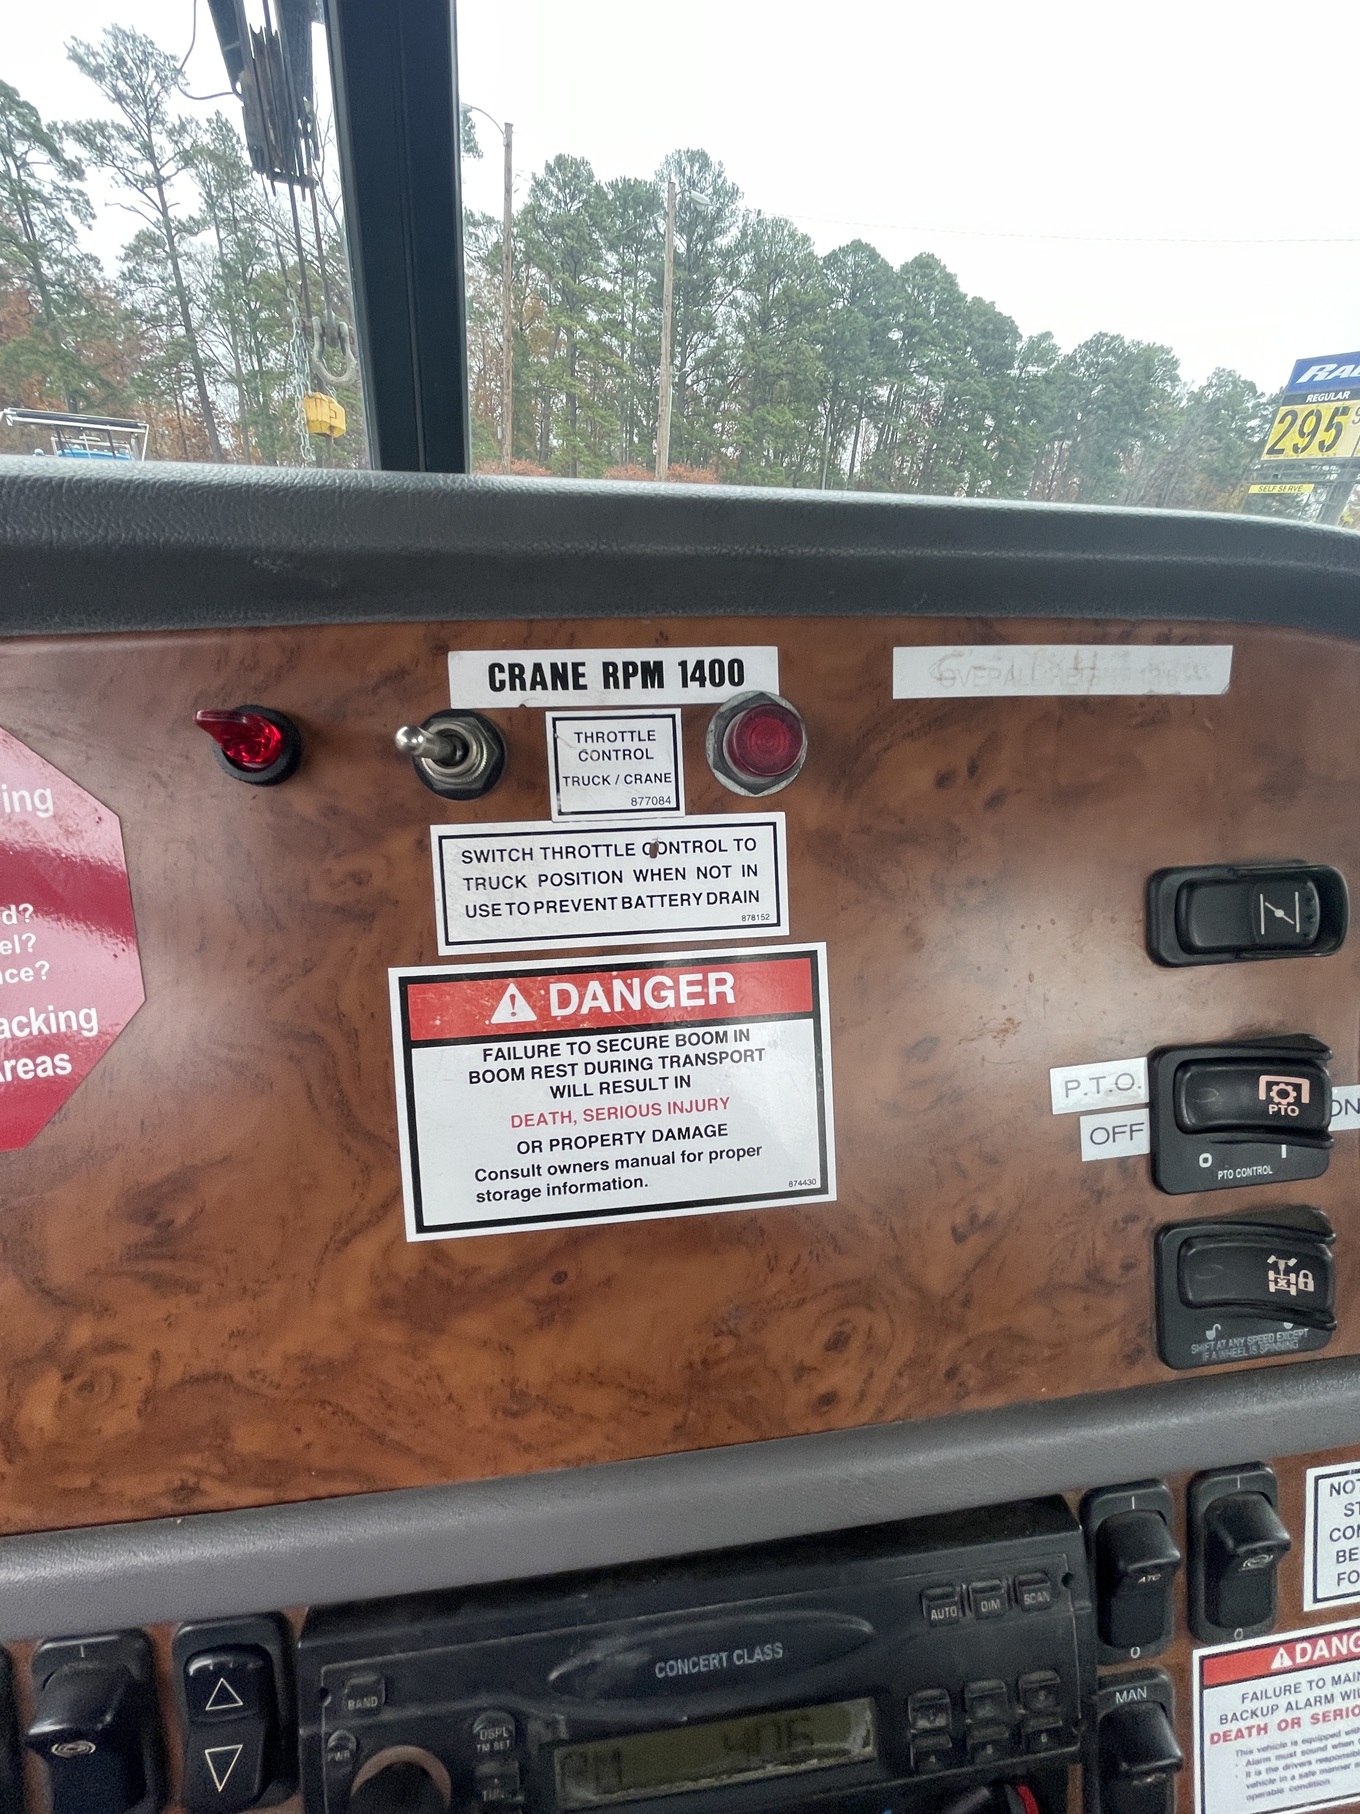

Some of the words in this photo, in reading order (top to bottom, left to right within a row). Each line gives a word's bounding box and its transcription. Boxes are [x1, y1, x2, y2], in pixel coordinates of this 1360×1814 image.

[1306, 390, 1351, 403] REGULAR
[1266, 405, 1351, 456] 295
[1258, 485, 1277, 493] SELF
[1278, 484, 1303, 493] SERVE
[488, 661, 588, 693] CRANE
[602, 659, 665, 690] RPM
[677, 657, 745, 688] 1400
[574, 730, 657, 744] THROTTLE
[577, 749, 654, 762] CONTROL
[562, 775, 611, 787] TRUCK
[624, 772, 672, 785] CRANE
[630, 795, 672, 806] 877084
[461, 847, 534, 865] SWITCH
[540, 843, 636, 861] THROTTLE
[733, 837, 757, 851] TO
[463, 874, 527, 892] TRUCK
[537, 869, 624, 888] POSITION
[633, 867, 687, 883] WHEN
[696, 864, 732, 880] NOT
[741, 863, 759, 877] IN
[465, 903, 503, 919] USE
[505, 901, 531, 916] TO
[534, 895, 618, 915] PREVENT
[621, 891, 704, 911] BATTERY
[705, 889, 760, 906] DRAIN
[741, 913, 771, 923] 878152
[549, 970, 736, 1018] DANGER
[482, 1043, 562, 1063] FAILURE
[566, 1041, 592, 1056] TO
[596, 1034, 671, 1055] SECURE
[675, 1031, 729, 1047] BOOM
[733, 1028, 751, 1043] IN
[468, 1067, 526, 1085] BOOM
[530, 1063, 579, 1081] REST
[584, 1057, 654, 1077] DURING
[658, 1048, 766, 1070] TRANSPORT
[550, 1083, 594, 1100] WILL
[599, 1076, 669, 1096] RESULT
[674, 1075, 692, 1089] IN
[1064, 1071, 1142, 1099] P.T.O.
[510, 1110, 578, 1129] DEATH,
[582, 1102, 663, 1126] SERIOUS
[667, 1096, 731, 1116] INJURY
[1268, 1104, 1299, 1117] PTO
[516, 1139, 544, 1155] OR
[549, 1131, 647, 1153] PROPERTY
[651, 1123, 729, 1143] DAMAGE
[1089, 1121, 1145, 1145] OFF
[474, 1164, 543, 1182] Consult
[546, 1161, 610, 1177] owners
[614, 1152, 676, 1170] manual
[680, 1148, 705, 1164] for
[708, 1145, 763, 1167] proper
[1217, 1169, 1234, 1180] PTO
[1235, 1164, 1273, 1178] CONTROL
[475, 1184, 542, 1205] storage
[546, 1175, 649, 1197] information.
[788, 1177, 818, 1188] 874430
[1191, 1342, 1216, 1354] SHIFT
[1216, 1340, 1227, 1350] AT
[1228, 1337, 1246, 1348] ANY
[1246, 1333, 1275, 1345] SPEED
[1276, 1328, 1309, 1340] EXCEPT
[1210, 1352, 1218, 1361] A
[1219, 1347, 1249, 1358] WHEEL
[981, 1600, 1000, 1612] DIM
[1023, 1591, 1050, 1605] SCAN
[931, 1606, 958, 1620] AUTO
[655, 1652, 729, 1679] CONCERT
[732, 1642, 783, 1665] CLASS
[348, 1696, 379, 1710] BAND
[1115, 1686, 1148, 1704] MAN
[1241, 1682, 1302, 1704] FAILURE
[1307, 1677, 1326, 1691] TO
[1219, 1703, 1279, 1725] BACKUP
[1285, 1693, 1335, 1713] ALARM
[1209, 1722, 1269, 1746] DEATH
[1277, 1717, 1302, 1732] OR
[1235, 1748, 1254, 1758] This
[1257, 1741, 1288, 1754] vehicle
[1291, 1739, 1299, 1747] is
[1301, 1730, 1342, 1746] equipped
[327, 1750, 350, 1762] PWR
[1245, 1755, 1272, 1767] Alarm
[1275, 1751, 1297, 1762] must
[1300, 1744, 1328, 1757] sound
[1331, 1740, 1355, 1750] when
[1246, 1778, 1277, 1790] vehicle
[1279, 1776, 1288, 1784] in
[1299, 1769, 1317, 1780] safe
[1319, 1763, 1351, 1775] manner
[1265, 1764, 1279, 1775] the
[1246, 1787, 1284, 1801] operable
[1289, 1778, 1331, 1792] condition
